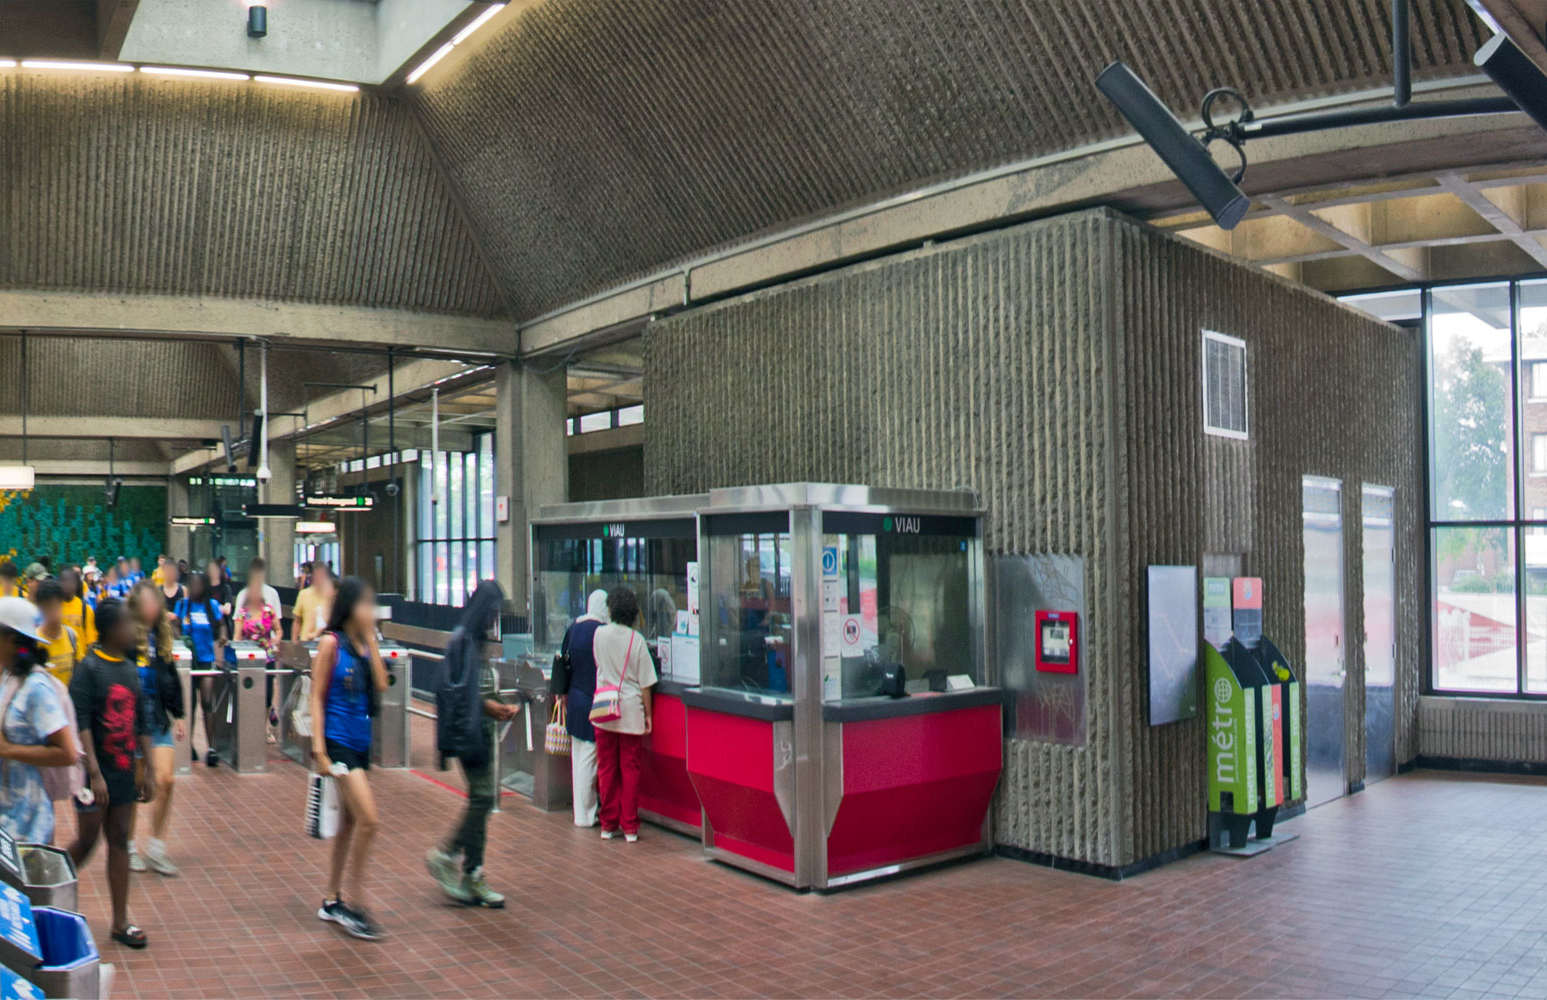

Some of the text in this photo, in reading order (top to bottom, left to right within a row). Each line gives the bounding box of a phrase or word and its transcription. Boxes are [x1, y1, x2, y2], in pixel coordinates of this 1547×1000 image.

[609, 524, 624, 537] VIAU
[895, 518, 920, 533] VIAU
[1212, 677, 1233, 784] métro
